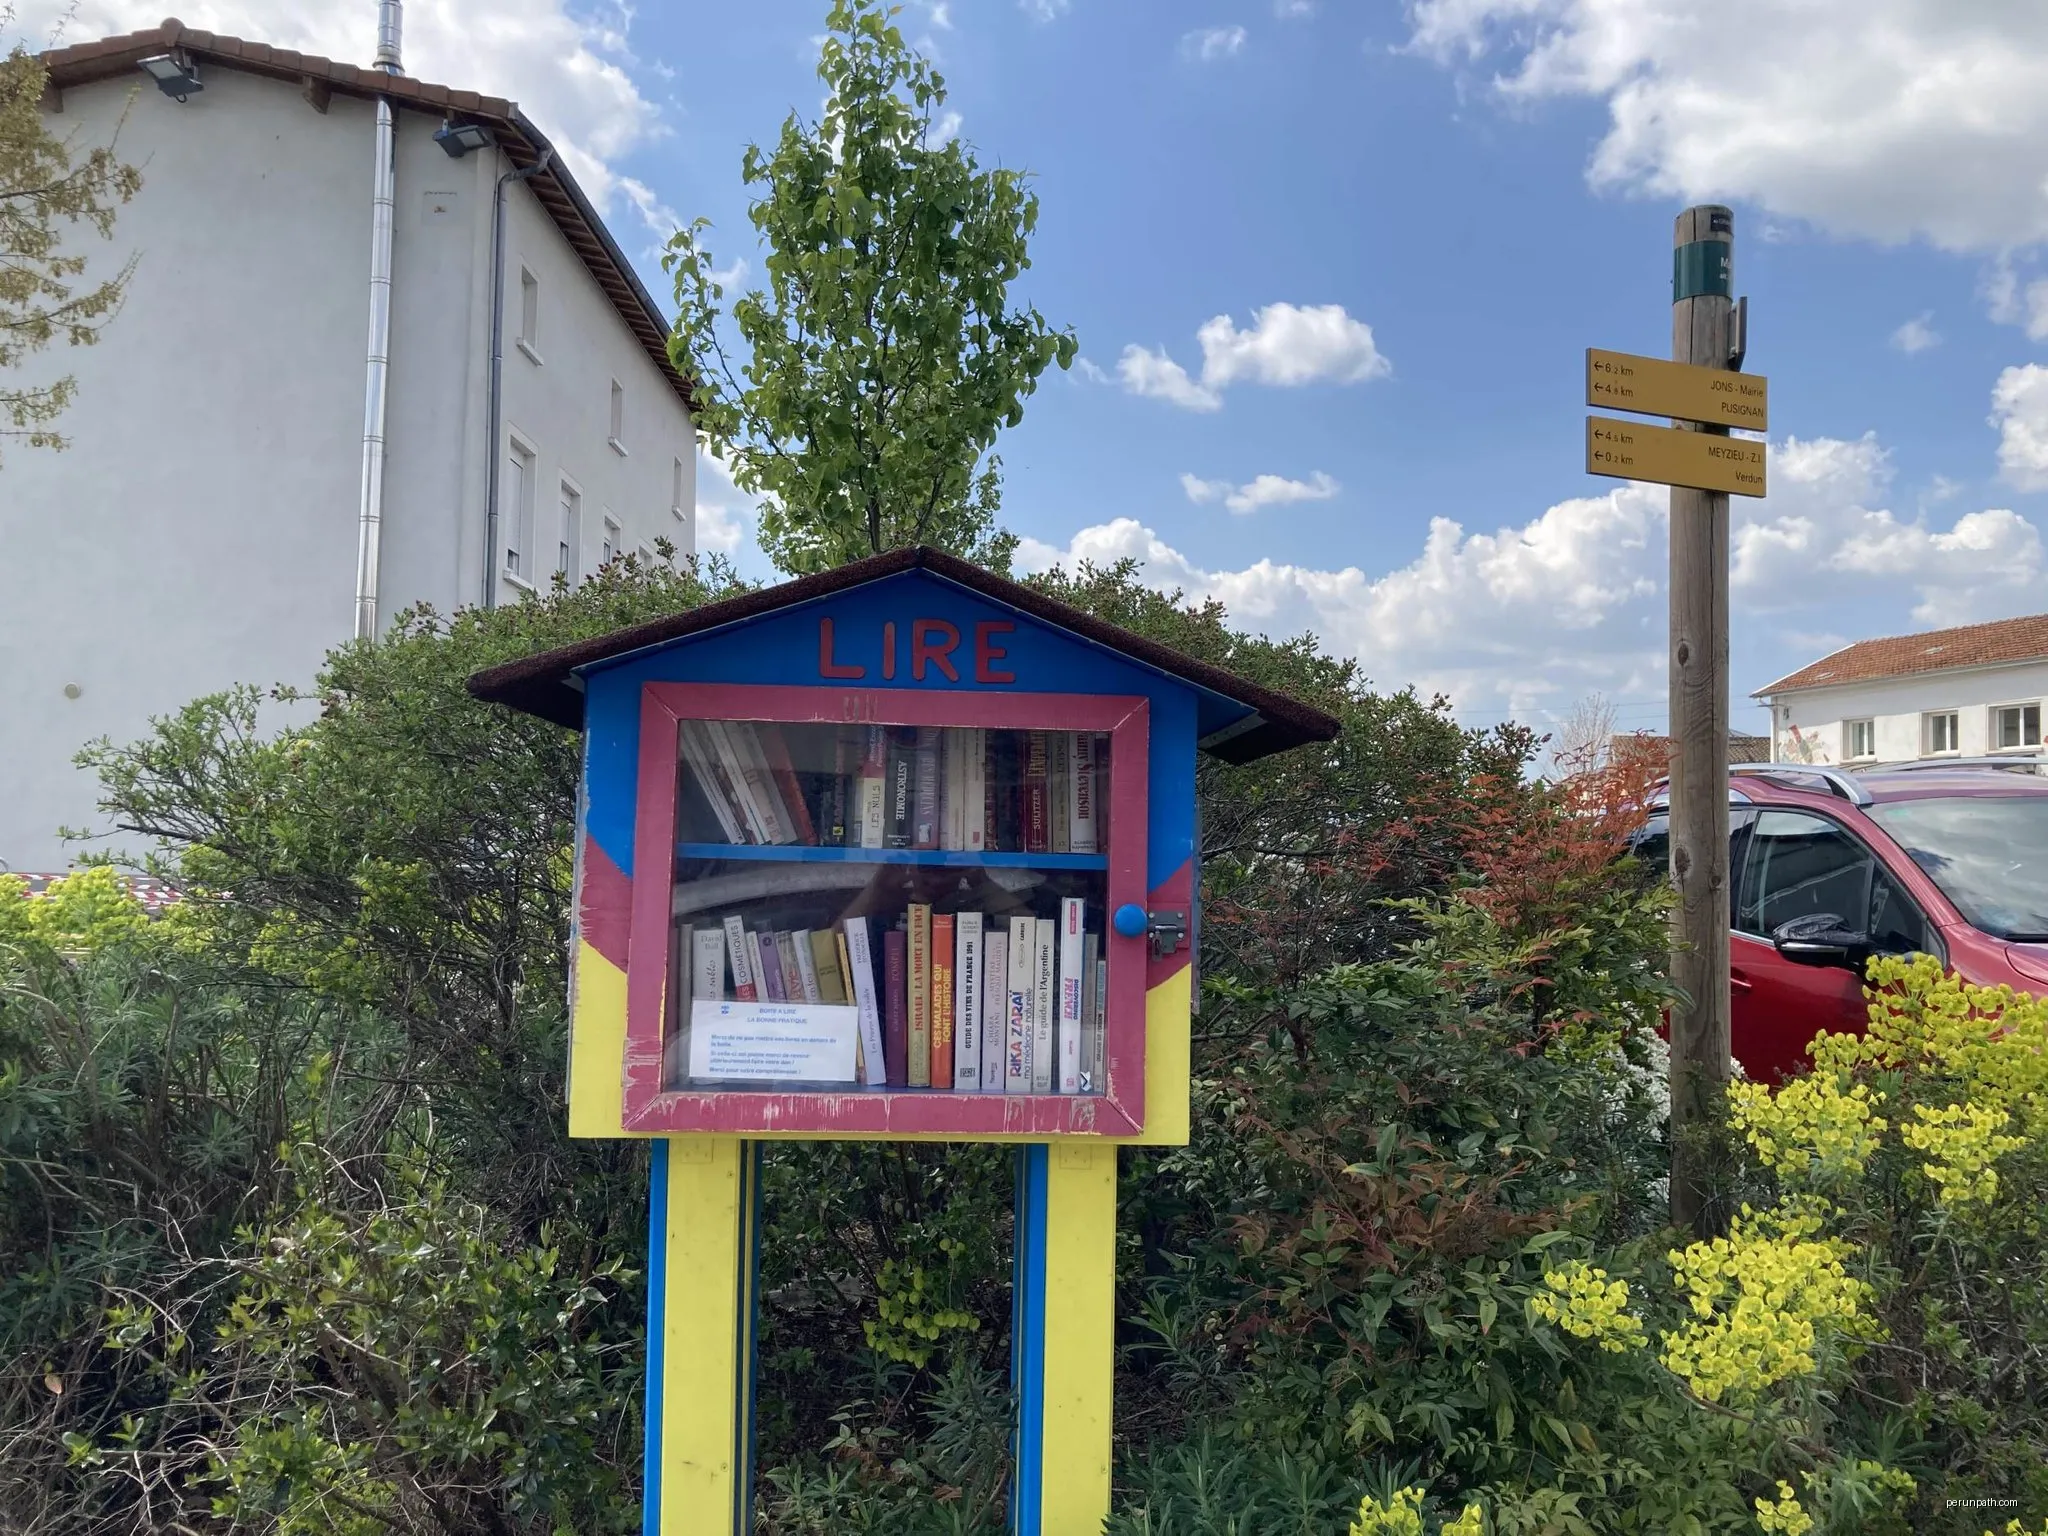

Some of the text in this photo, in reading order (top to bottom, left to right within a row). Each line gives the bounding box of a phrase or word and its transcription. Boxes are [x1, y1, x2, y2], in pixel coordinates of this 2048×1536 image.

[1621, 366, 1633, 376] km
[1621, 387, 1633, 397] km
[1711, 381, 1732, 392] JONS
[1740, 385, 1763, 397] Mairie
[1721, 402, 1764, 417] PUSIGNAN
[1621, 434, 1633, 444] km
[1621, 455, 1633, 465] km
[1708, 446, 1744, 461] MEYZIEU
[1736, 471, 1762, 484] Verdun
[820, 617, 1016, 682] LIRE
[1072, 734, 1091, 761] anny
[872, 785, 880, 808] NULS
[896, 760, 907, 820] ASTRONOMIE
[1076, 763, 1095, 819] Stevenson
[1033, 789, 1041, 830] SULITZER
[914, 905, 922, 929] FACE
[914, 930, 922, 944] EN
[914, 948, 922, 973] MORT
[915, 975, 923, 989] LA
[966, 985, 972, 993] DE
[1038, 944, 1050, 1040] Le guide de l'Argentine
[934, 964, 942, 1048] CES MALADES QUI
[942, 968, 951, 1043] FONT L'HISTOIRE
[1063, 977, 1073, 1019] FRENCH
[1009, 990, 1023, 1077] RIKA ZARAÏ
[1023, 988, 1033, 1079] ma médecine naturelle
